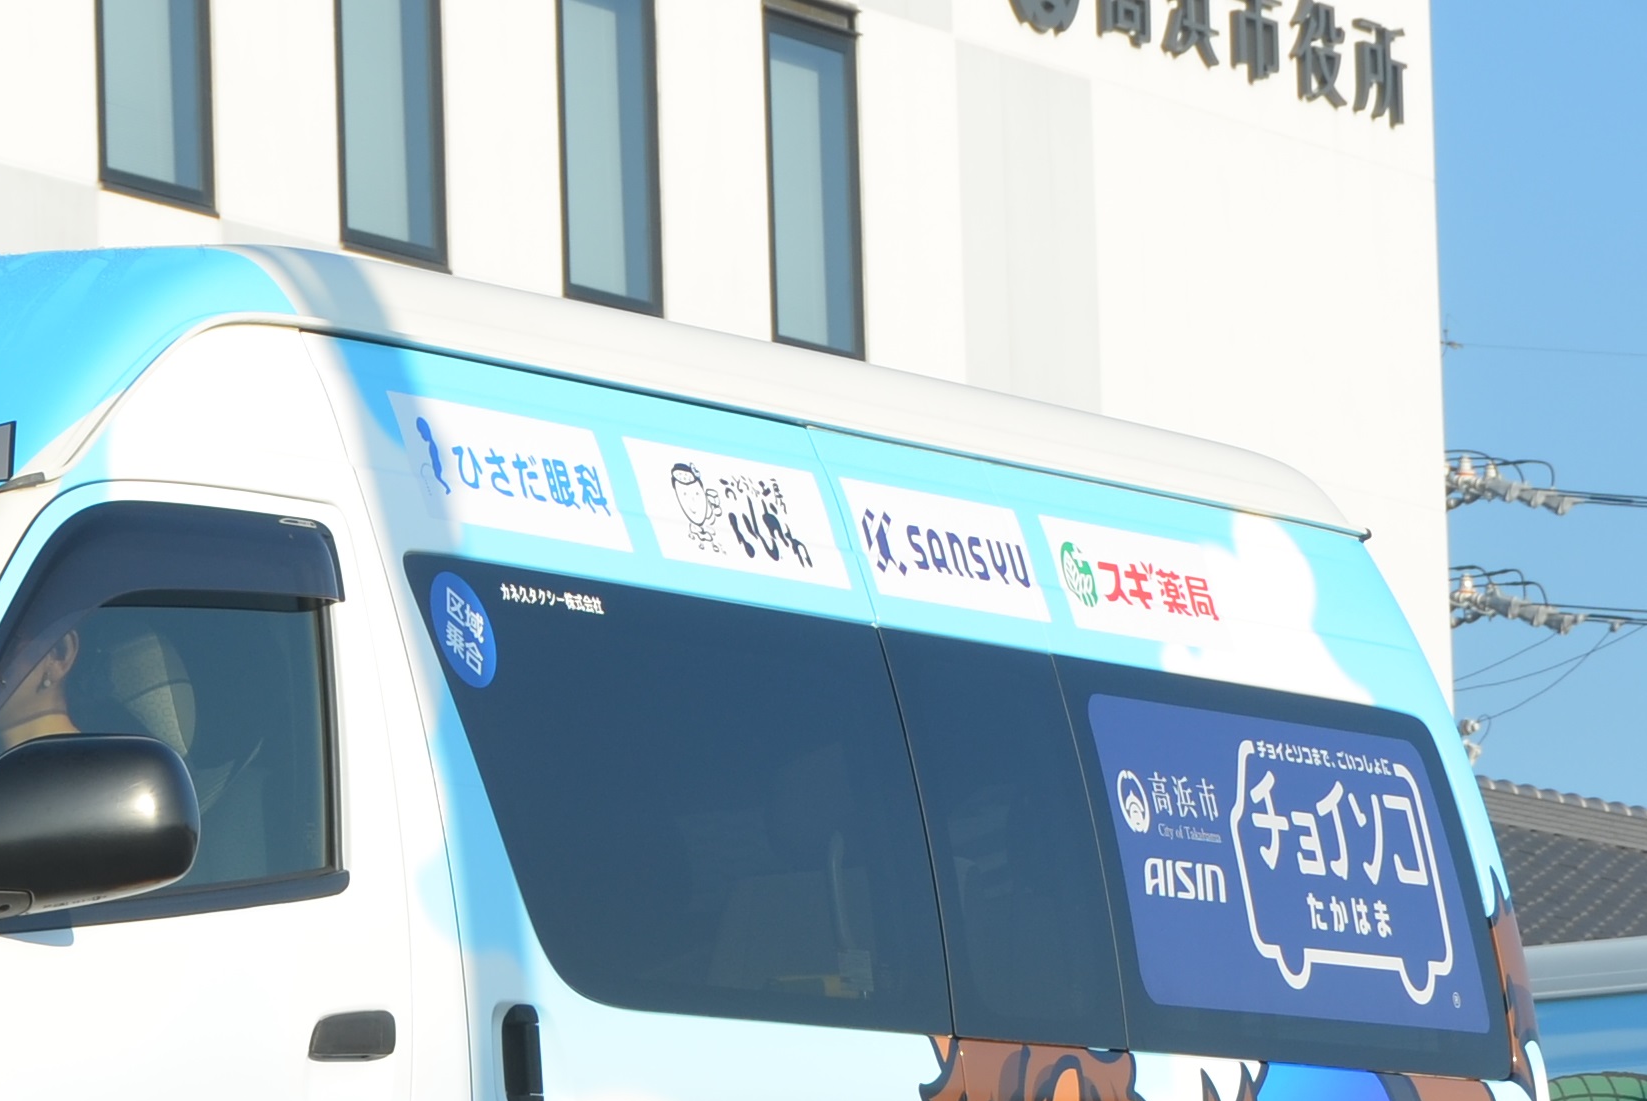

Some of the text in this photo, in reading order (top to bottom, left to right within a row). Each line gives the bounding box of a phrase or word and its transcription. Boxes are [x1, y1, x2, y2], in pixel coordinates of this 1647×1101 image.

[451, 445, 612, 518] ひさだ眼科
[445, 586, 485, 644] 区域
[1096, 560, 1220, 622] スギ薬局
[445, 620, 484, 677] 乗合
[1147, 770, 1219, 822] 高浜市
[1249, 769, 1429, 886] チョイソコ
[1144, 856, 1227, 904] AISIN
[1306, 891, 1393, 938] たかはま
